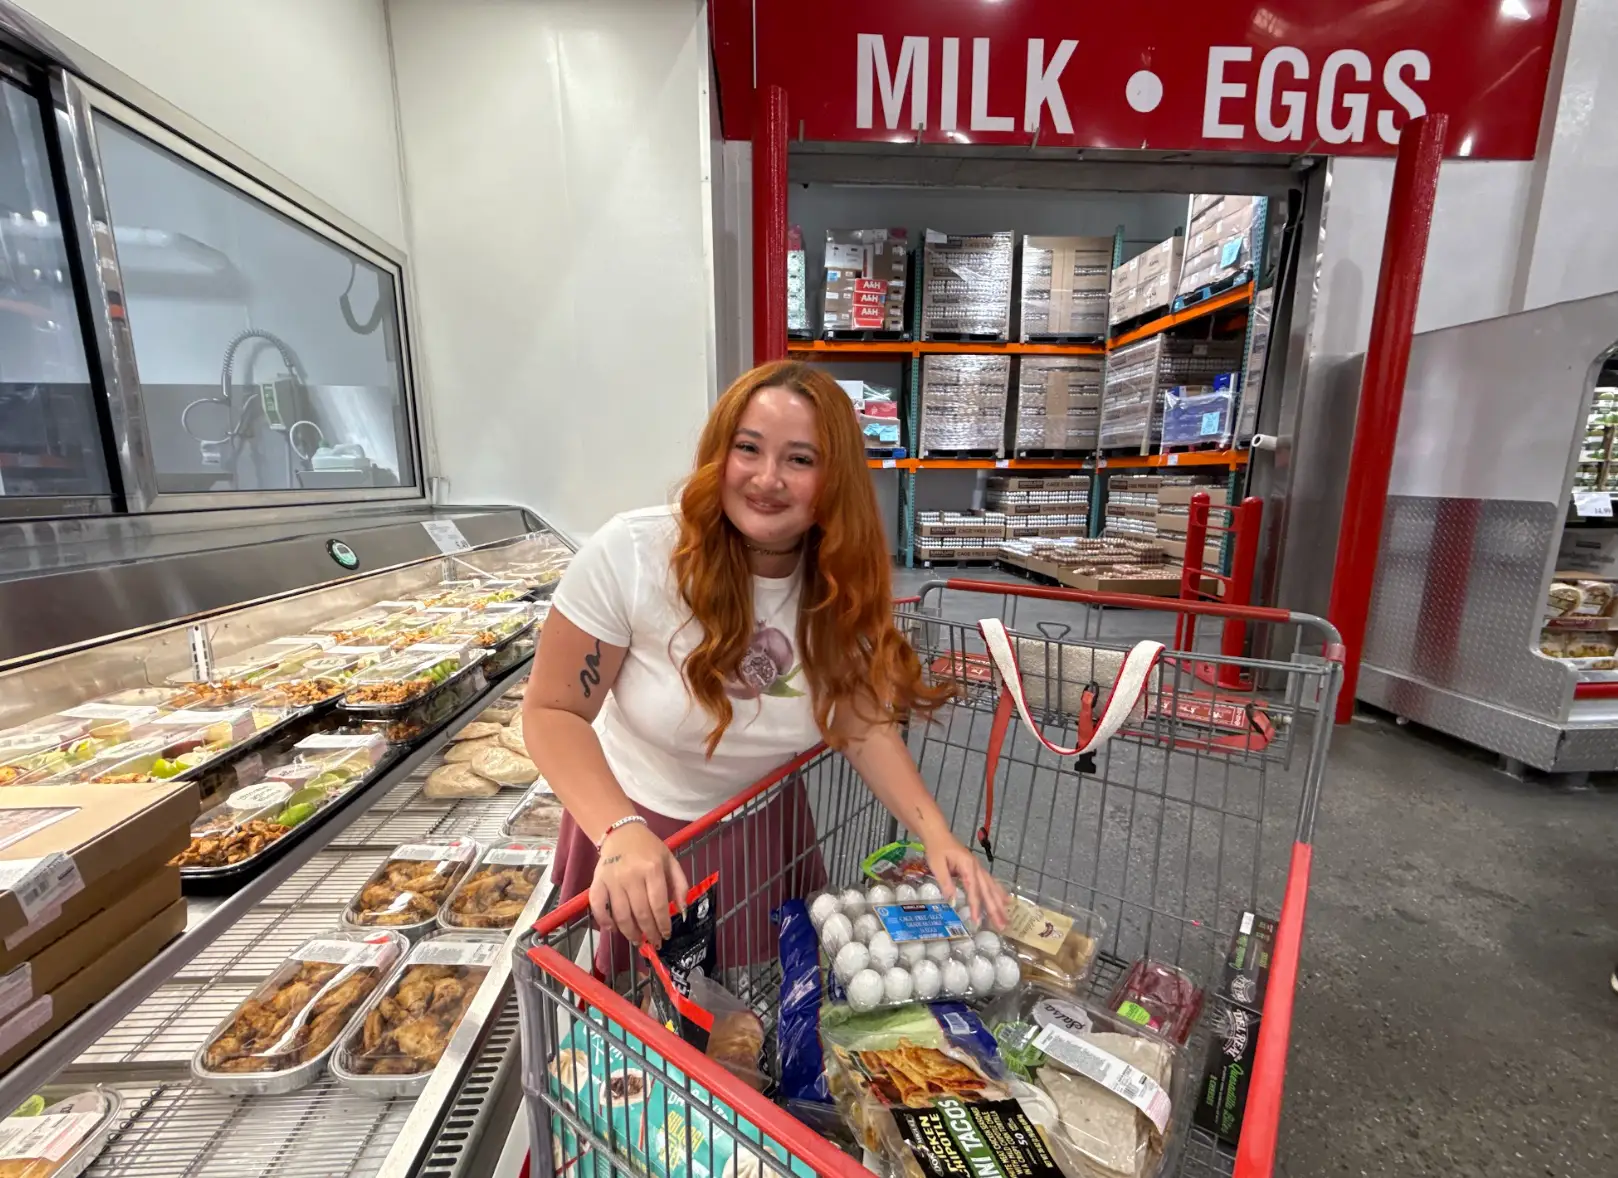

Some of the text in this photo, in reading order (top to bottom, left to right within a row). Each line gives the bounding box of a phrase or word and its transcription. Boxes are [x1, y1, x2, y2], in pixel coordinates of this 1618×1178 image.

[856, 33, 1432, 146] MILK EGGS
[862, 281, 881, 289] A&H
[860, 294, 879, 303] A&H
[860, 307, 879, 316] A&H
[1044, 1004, 1086, 1030] Salsa
[1228, 1009, 1247, 1059] DEL REAL
[938, 1099, 984, 1152] TACOS
[1014, 1132, 1029, 1146] 50
